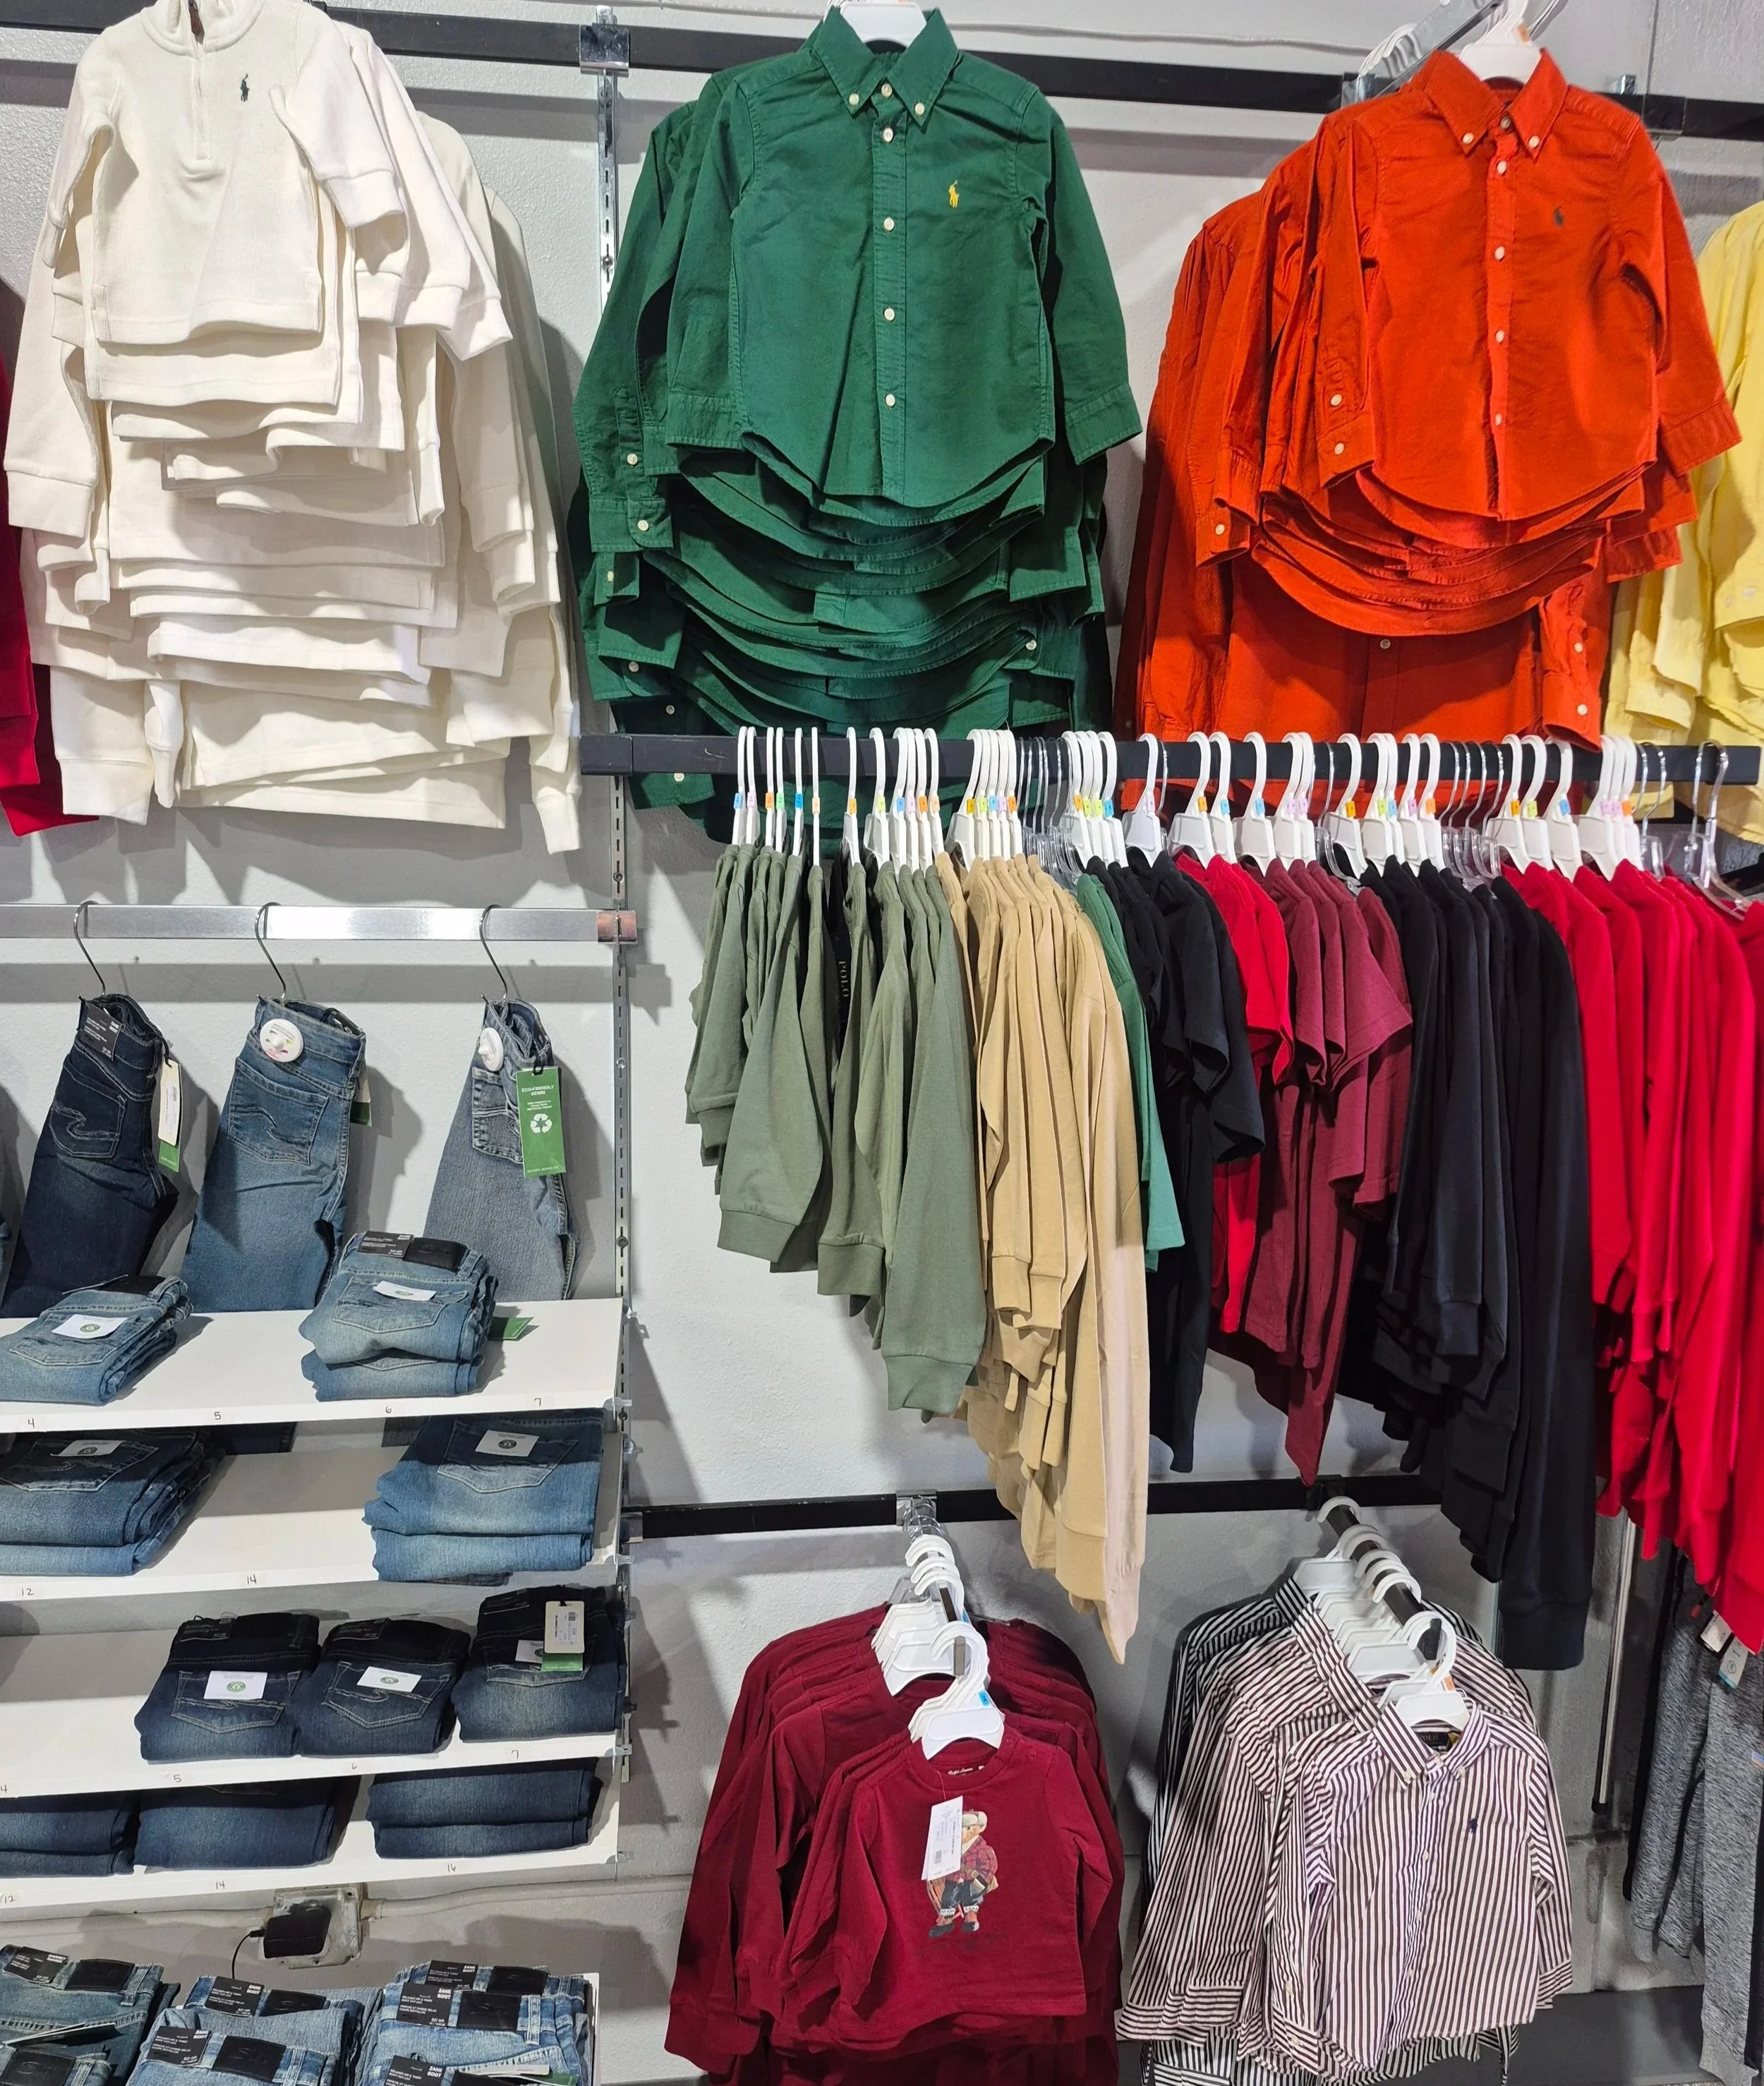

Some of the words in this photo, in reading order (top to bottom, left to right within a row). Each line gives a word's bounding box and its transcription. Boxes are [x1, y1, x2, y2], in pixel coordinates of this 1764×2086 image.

[534, 1397, 541, 1407] 7
[214, 1411, 222, 1421] 5
[28, 1418, 35, 1428] 4
[247, 1574, 257, 1585] 14
[21, 1588, 34, 1596] 12
[512, 1749, 519, 1759] 7
[173, 1774, 181, 1783] 5
[0, 1784, 8, 1793] 4
[215, 1881, 225, 1890] 14
[4, 1895, 16, 1904] 12
